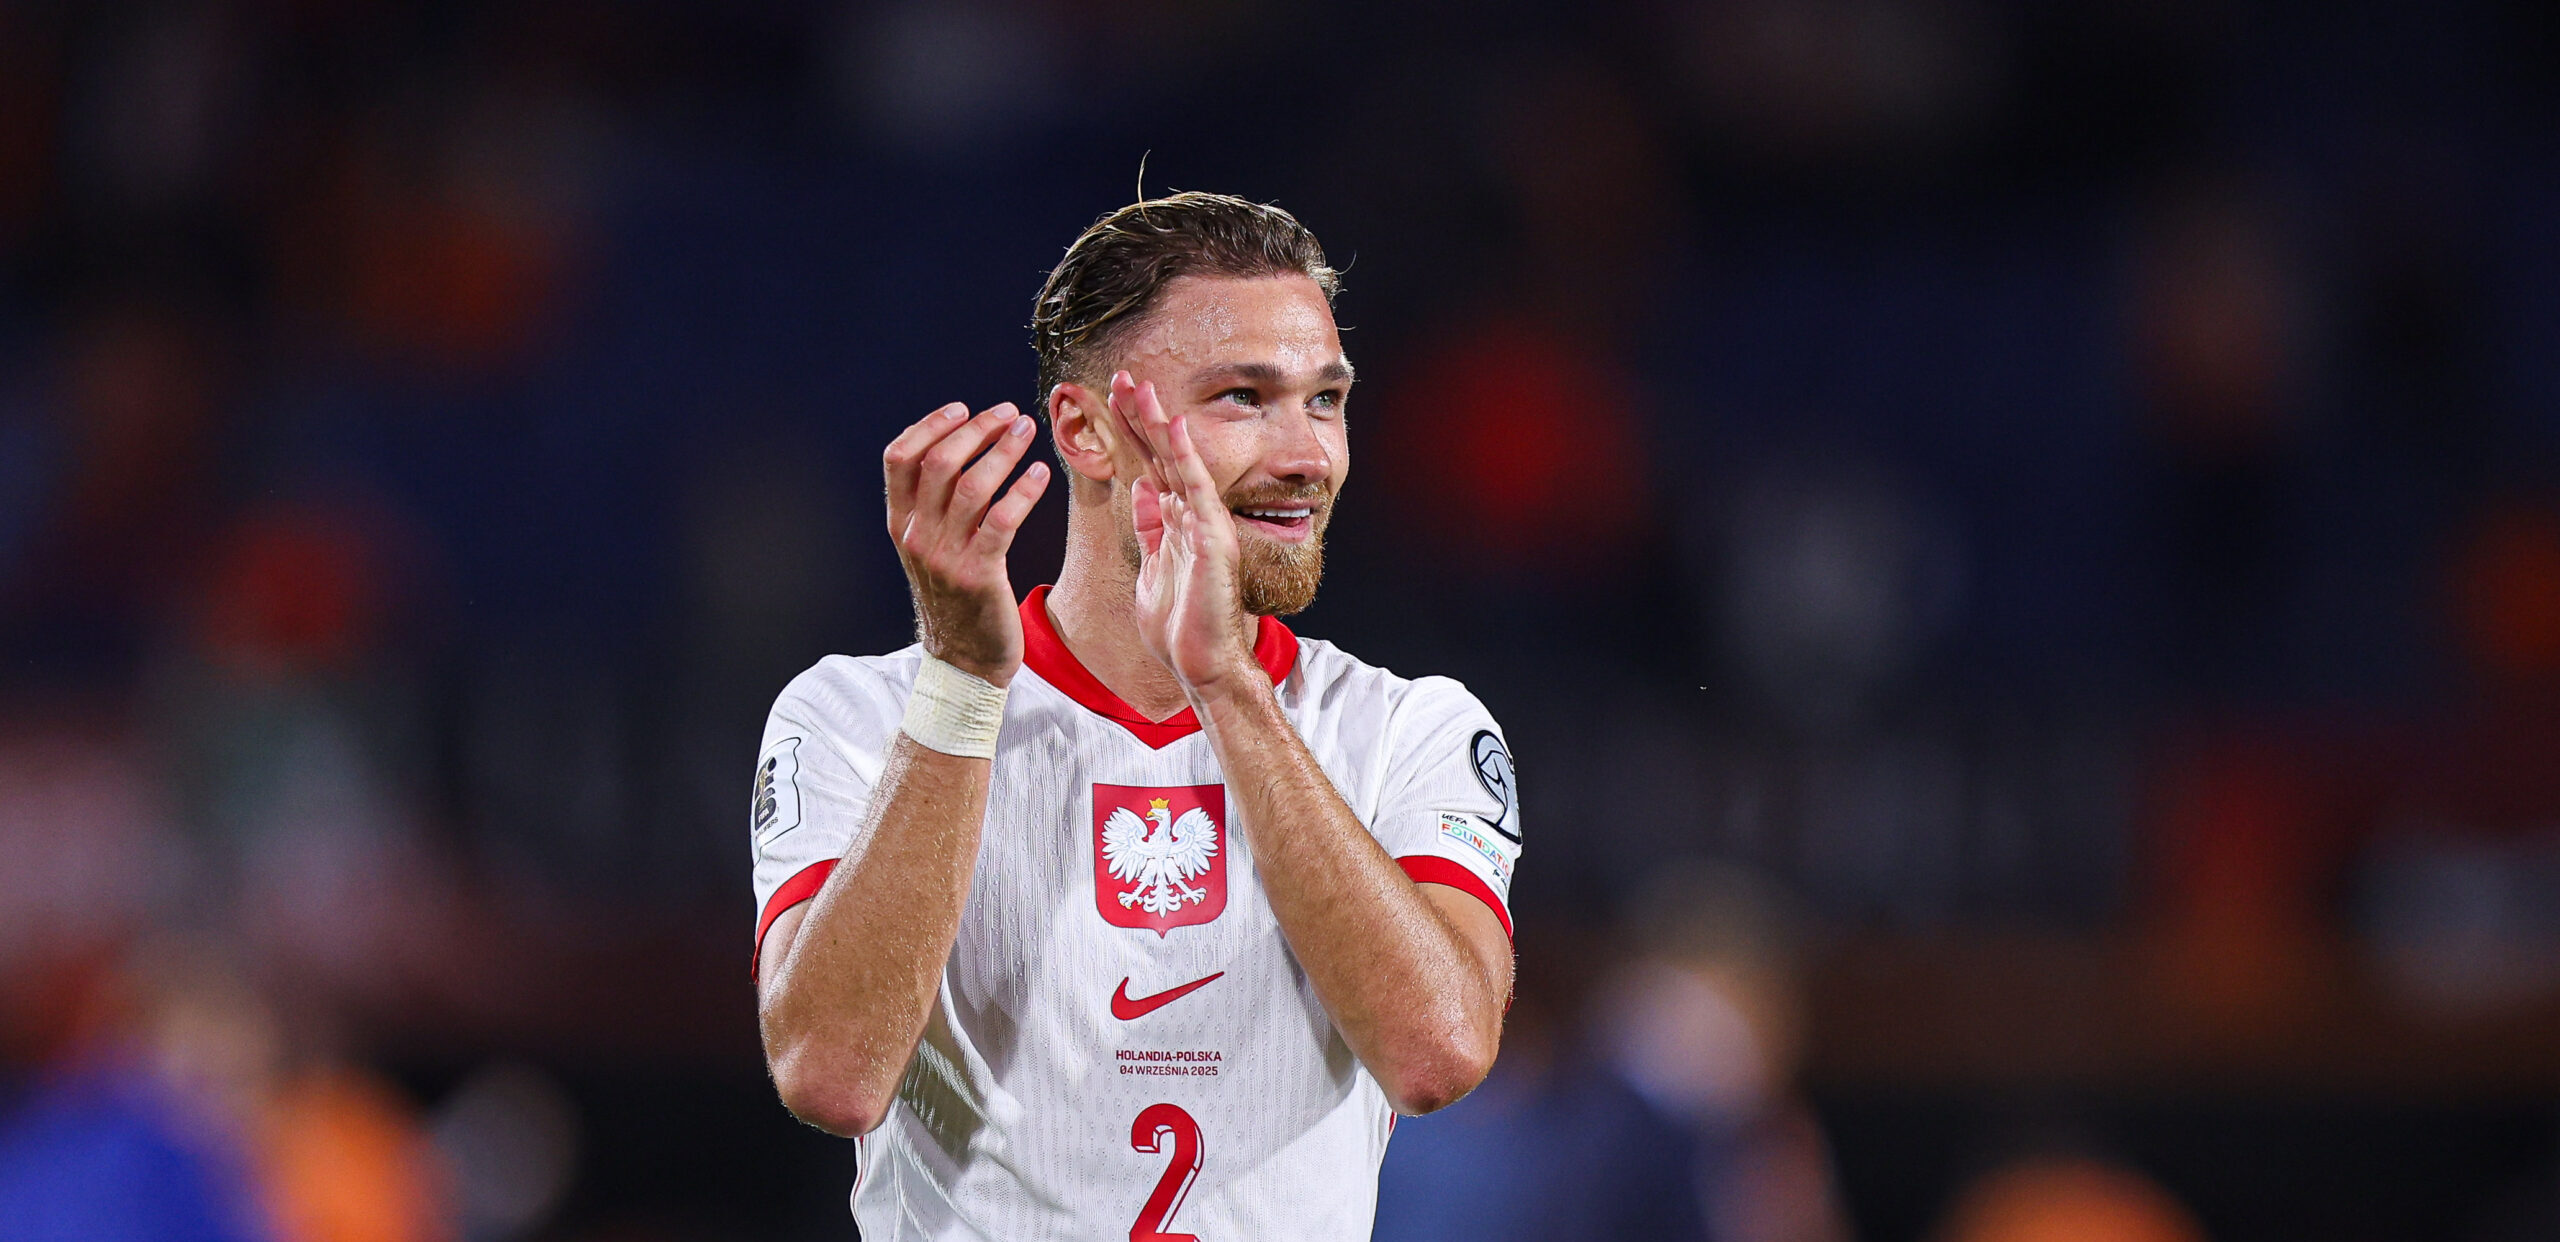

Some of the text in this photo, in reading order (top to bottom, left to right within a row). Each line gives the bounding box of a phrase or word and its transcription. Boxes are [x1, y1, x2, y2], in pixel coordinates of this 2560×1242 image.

[1441, 813, 1467, 825] UEFA
[1115, 1049, 1222, 1062] HOLANDIA-POLSKA
[1119, 1064, 1219, 1076] 04 WRZEŚNIA 2025
[1129, 1103, 1205, 1242] 2
